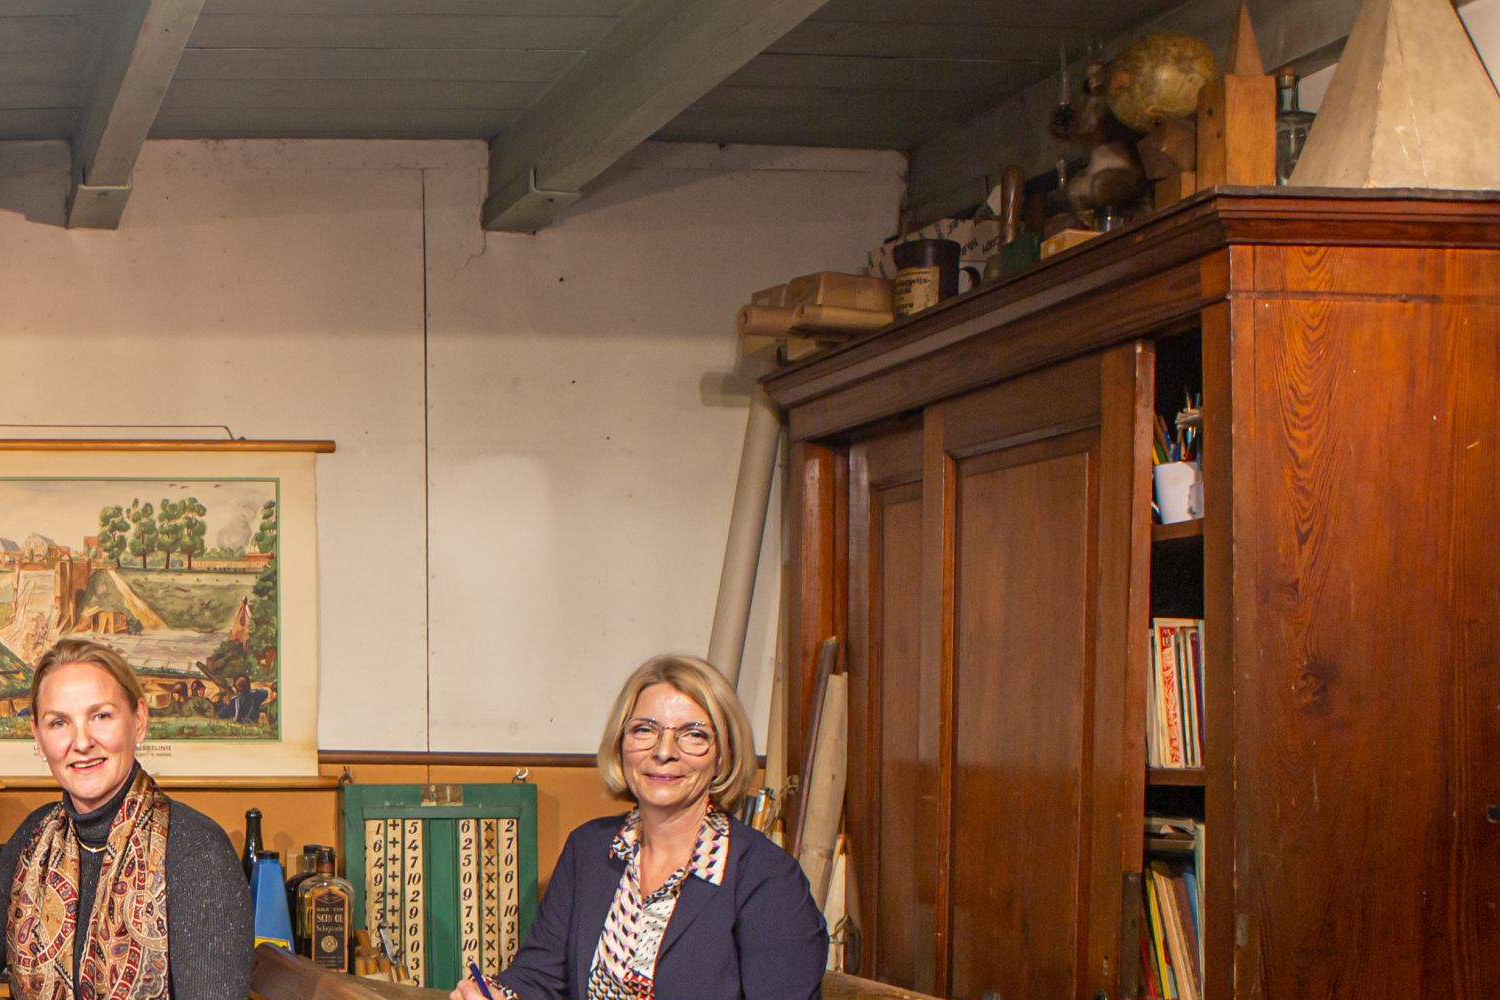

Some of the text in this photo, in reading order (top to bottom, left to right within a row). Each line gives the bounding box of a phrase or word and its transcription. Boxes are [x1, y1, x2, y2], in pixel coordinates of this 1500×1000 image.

[376, 823, 381, 835] 1
[409, 822, 418, 834] 5
[461, 820, 470, 833] 6
[505, 820, 514, 832] 2
[373, 840, 382, 852] 6
[407, 840, 419, 851] 4
[462, 838, 472, 850] 2
[506, 837, 514, 849] 7
[373, 857, 384, 869] 4
[411, 856, 418, 868] 7
[462, 854, 472, 867] 5
[505, 853, 513, 866] 0
[374, 873, 382, 886] 9
[407, 872, 421, 885] 10
[463, 871, 472, 884] 0
[505, 870, 514, 883] 6
[374, 891, 384, 903] 2
[410, 890, 420, 902] 2
[463, 888, 472, 901] 9
[508, 888, 513, 900] 1
[375, 909, 383, 920] 5
[409, 906, 418, 919] 9
[465, 906, 473, 917] 7
[504, 904, 518, 917] 10
[409, 923, 418, 936] 6
[465, 922, 474, 934] 3
[506, 921, 514, 934] 3
[411, 940, 420, 953] 0
[463, 939, 477, 951] 10
[507, 939, 515, 951] 5
[411, 958, 420, 970] 3
